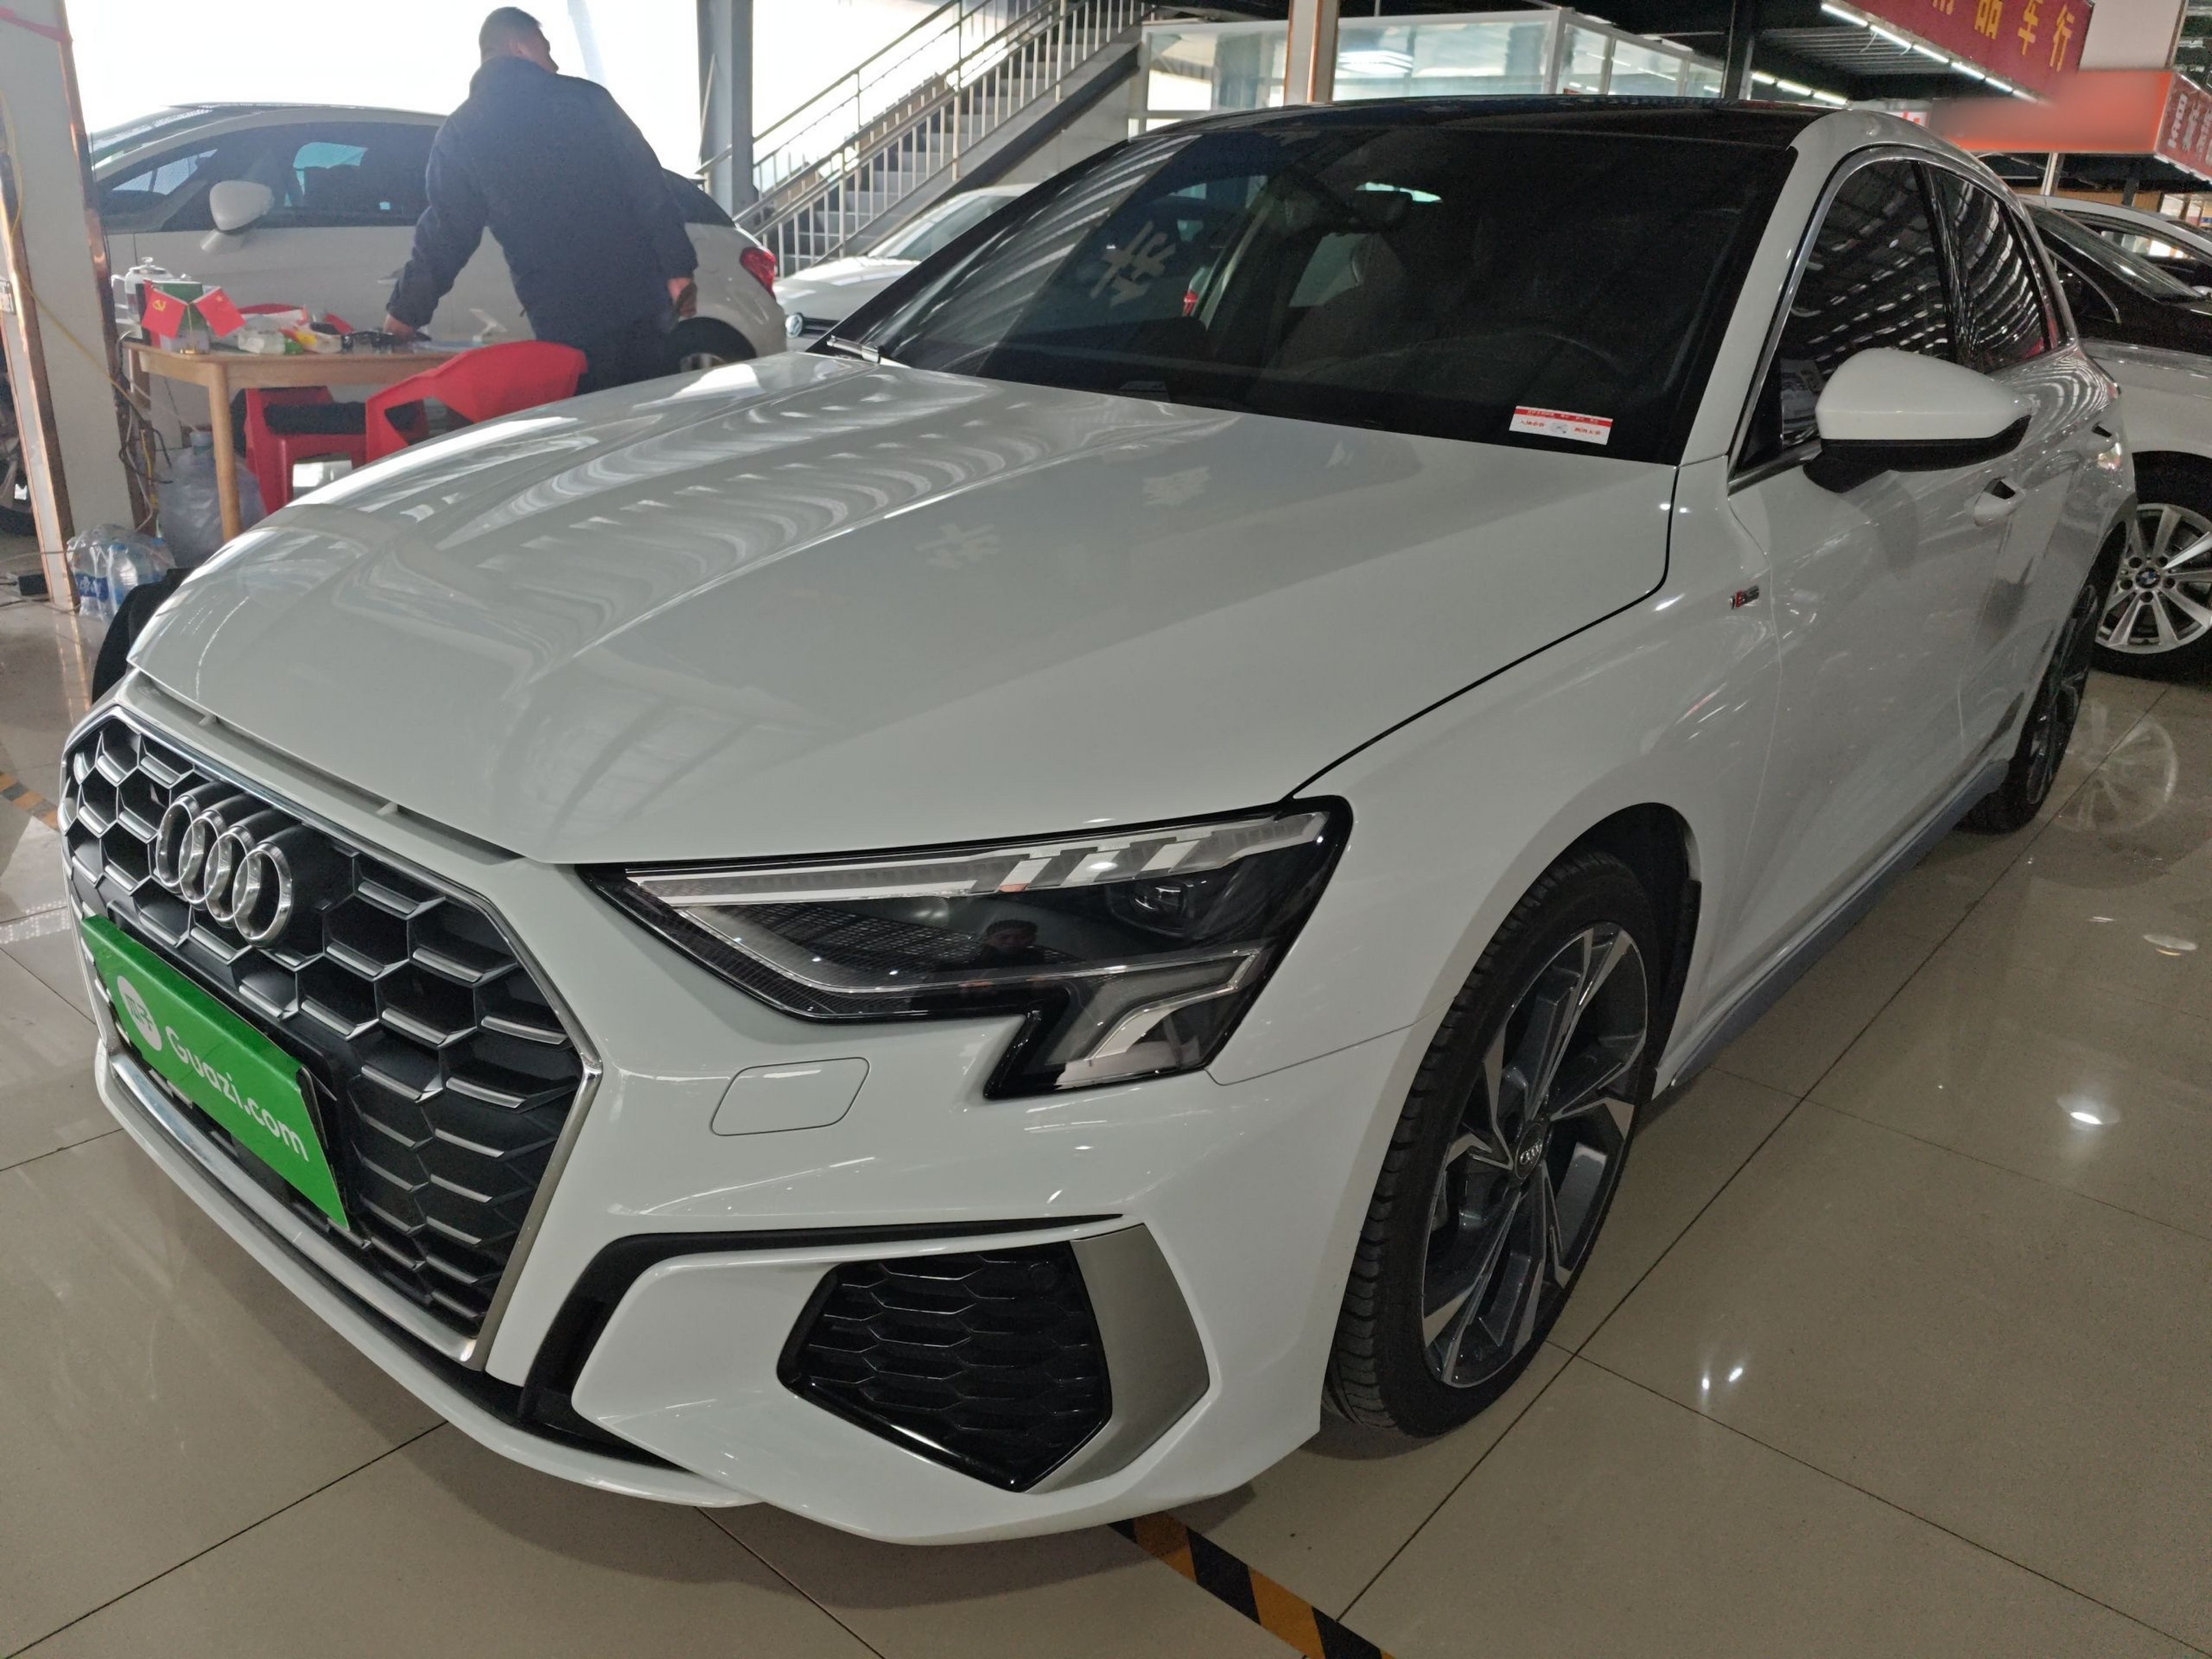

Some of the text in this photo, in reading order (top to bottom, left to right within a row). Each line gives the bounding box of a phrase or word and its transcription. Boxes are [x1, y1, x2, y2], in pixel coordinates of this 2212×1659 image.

[1933, 0, 2075, 71] 品车行
[165, 1026, 309, 1161] Guazi.com
